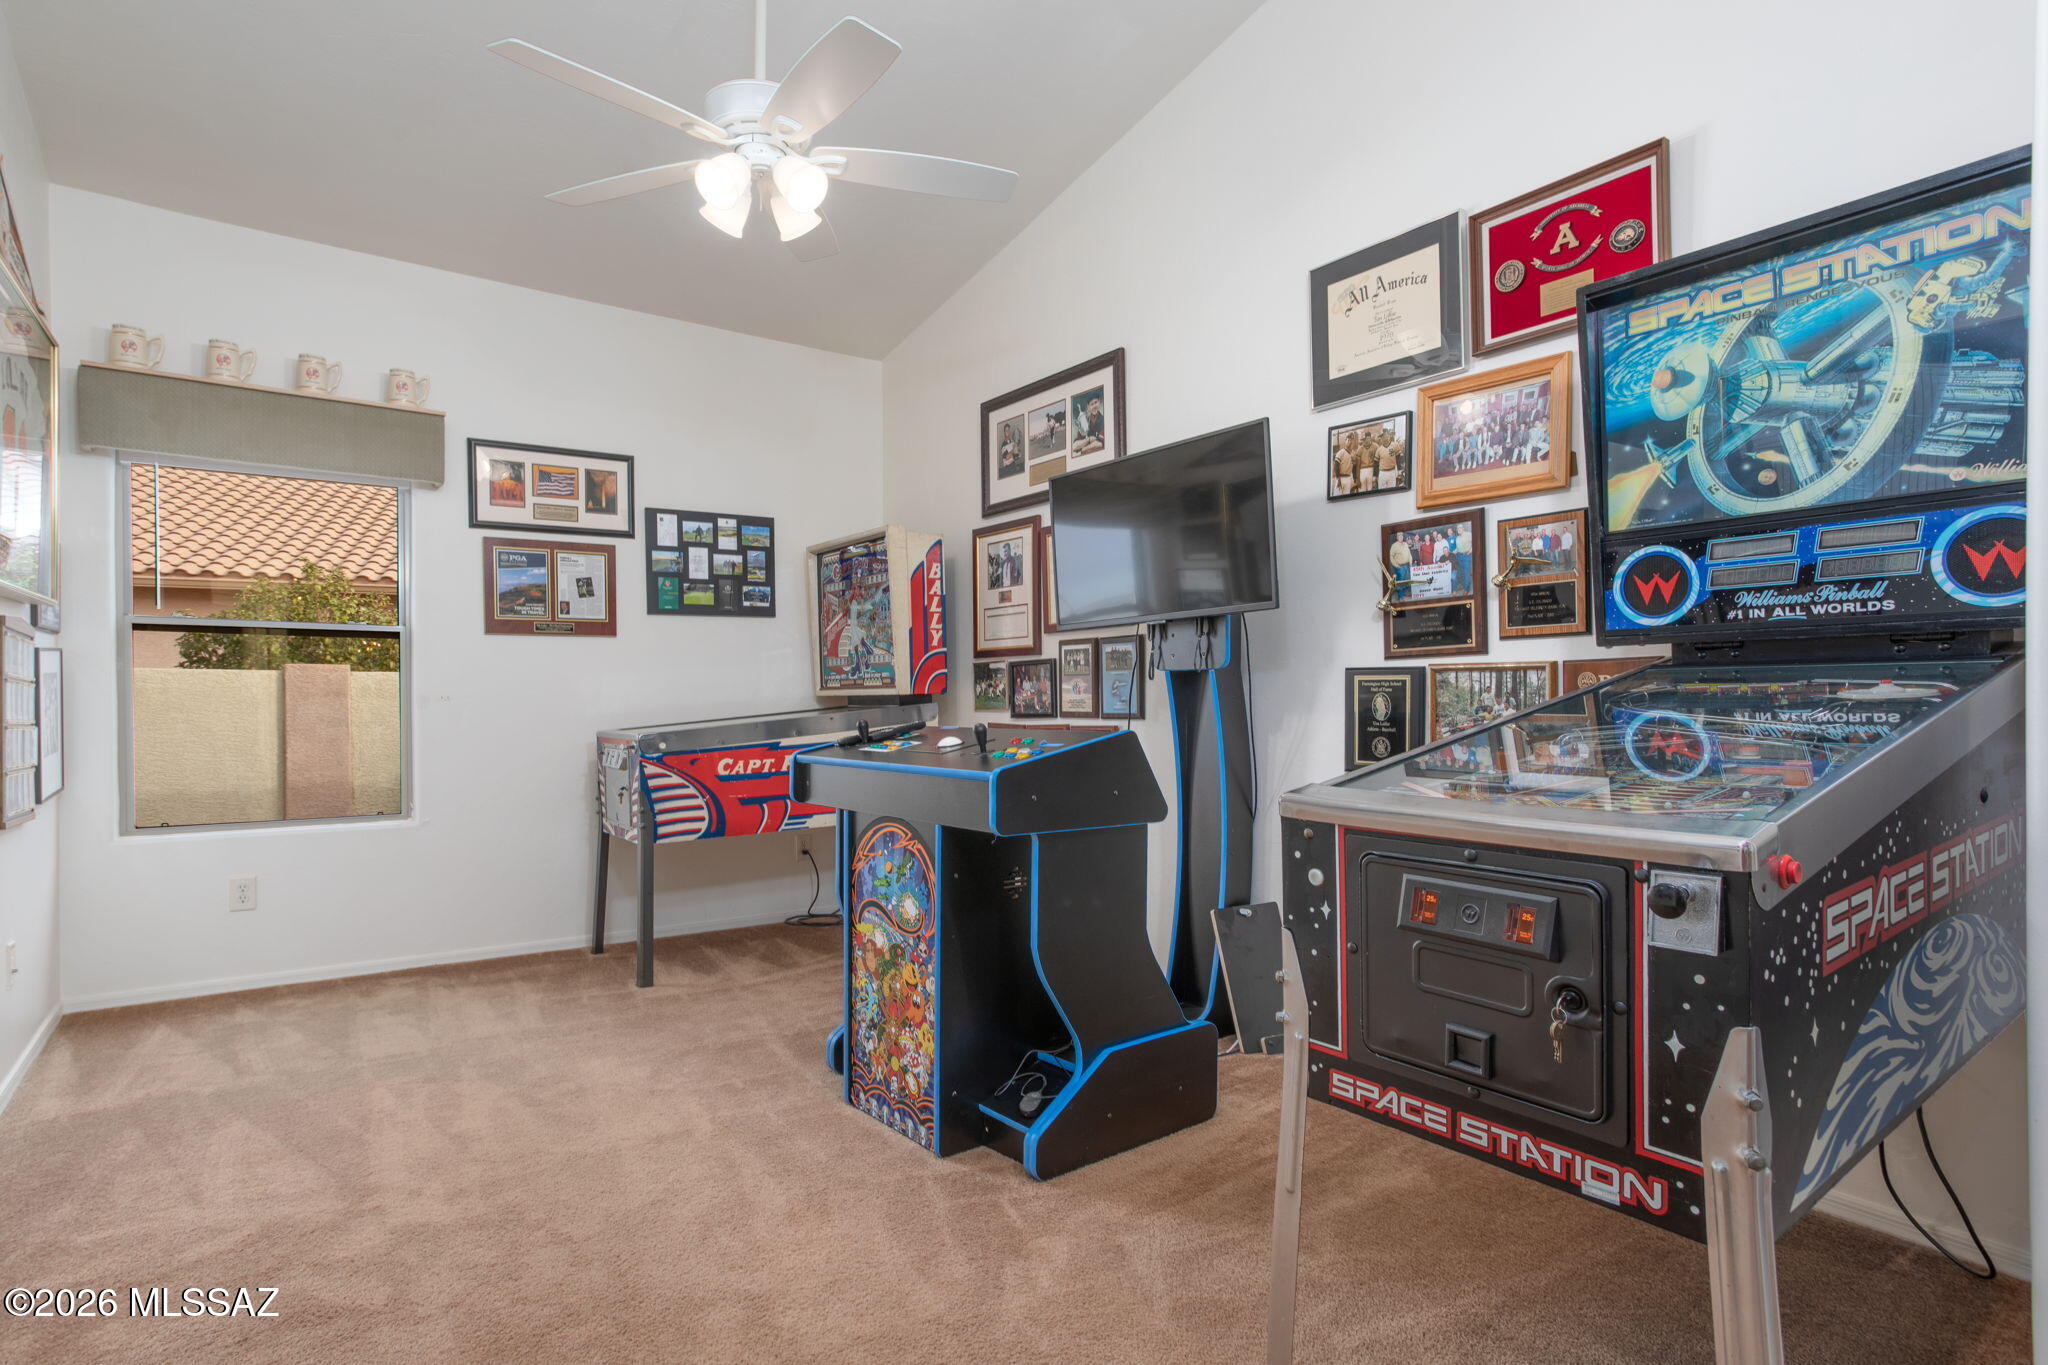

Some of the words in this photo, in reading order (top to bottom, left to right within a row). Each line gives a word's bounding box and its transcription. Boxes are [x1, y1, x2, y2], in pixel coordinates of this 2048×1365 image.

[1550, 221, 1580, 255] A
[1628, 271, 1775, 336] SPACE
[1781, 196, 2032, 293] STATION
[1345, 285, 1369, 318] All
[1372, 271, 1428, 303] America
[1716, 303, 1777, 327] PINBALL
[1785, 269, 1906, 308] RENDEZVOUS
[929, 563, 943, 647] BALLY
[1632, 571, 1681, 606] W
[1727, 610, 1743, 620] #1
[1749, 608, 1766, 619] IN
[1771, 606, 1807, 617] ALL
[1810, 599, 1896, 615] WORLDS
[1734, 589, 1814, 608] Williams
[1814, 580, 1889, 603] Pinball
[717, 757, 775, 776] CAPT.
[1826, 862, 1926, 963] SPACE
[1932, 813, 2024, 901] STATION
[1331, 1072, 1448, 1134] SPACE
[1459, 1114, 1664, 1211] STATION
